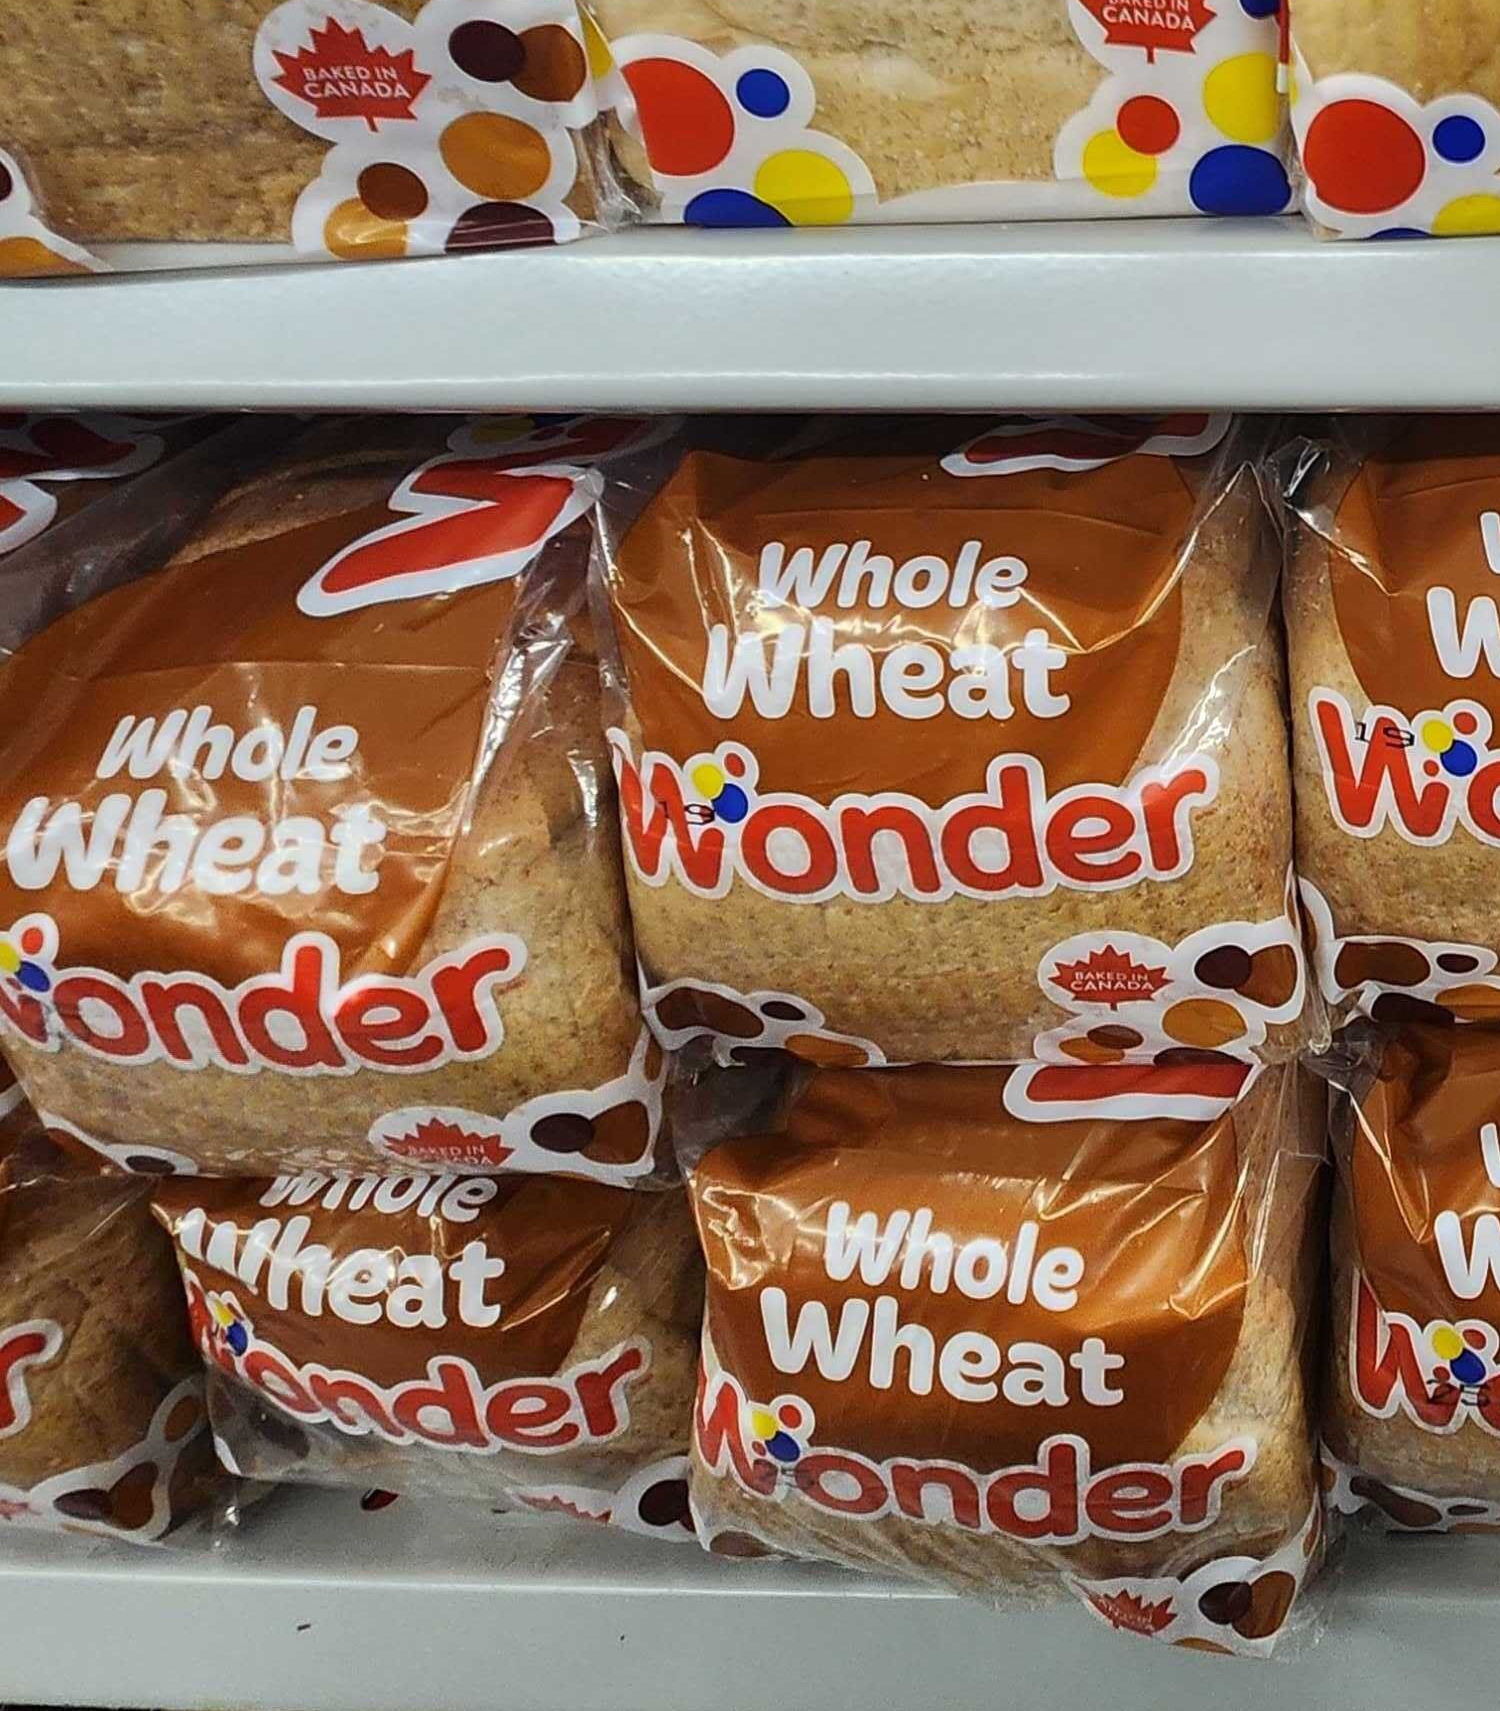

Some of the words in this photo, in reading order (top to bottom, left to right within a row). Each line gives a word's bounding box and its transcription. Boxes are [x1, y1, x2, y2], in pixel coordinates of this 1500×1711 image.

[1102, 5, 1196, 32] CANADA
[302, 65, 371, 81] BAKED
[374, 66, 398, 81] IN
[303, 81, 412, 99] CANADA
[758, 540, 1029, 609] Whole
[703, 619, 1071, 720] Wheat
[98, 705, 359, 782] Whole
[5, 790, 388, 894] Wheat
[617, 754, 1208, 892] Wonder
[1070, 980, 1155, 991] CANADA
[1075, 971, 1127, 981] BAKED
[1131, 971, 1149, 981] IN
[466, 1144, 486, 1155] IN
[176, 1207, 505, 1329] Wheat
[824, 1201, 1086, 1311] Whole
[760, 1286, 1126, 1408] Wheat
[697, 1362, 1246, 1538] Wonder
